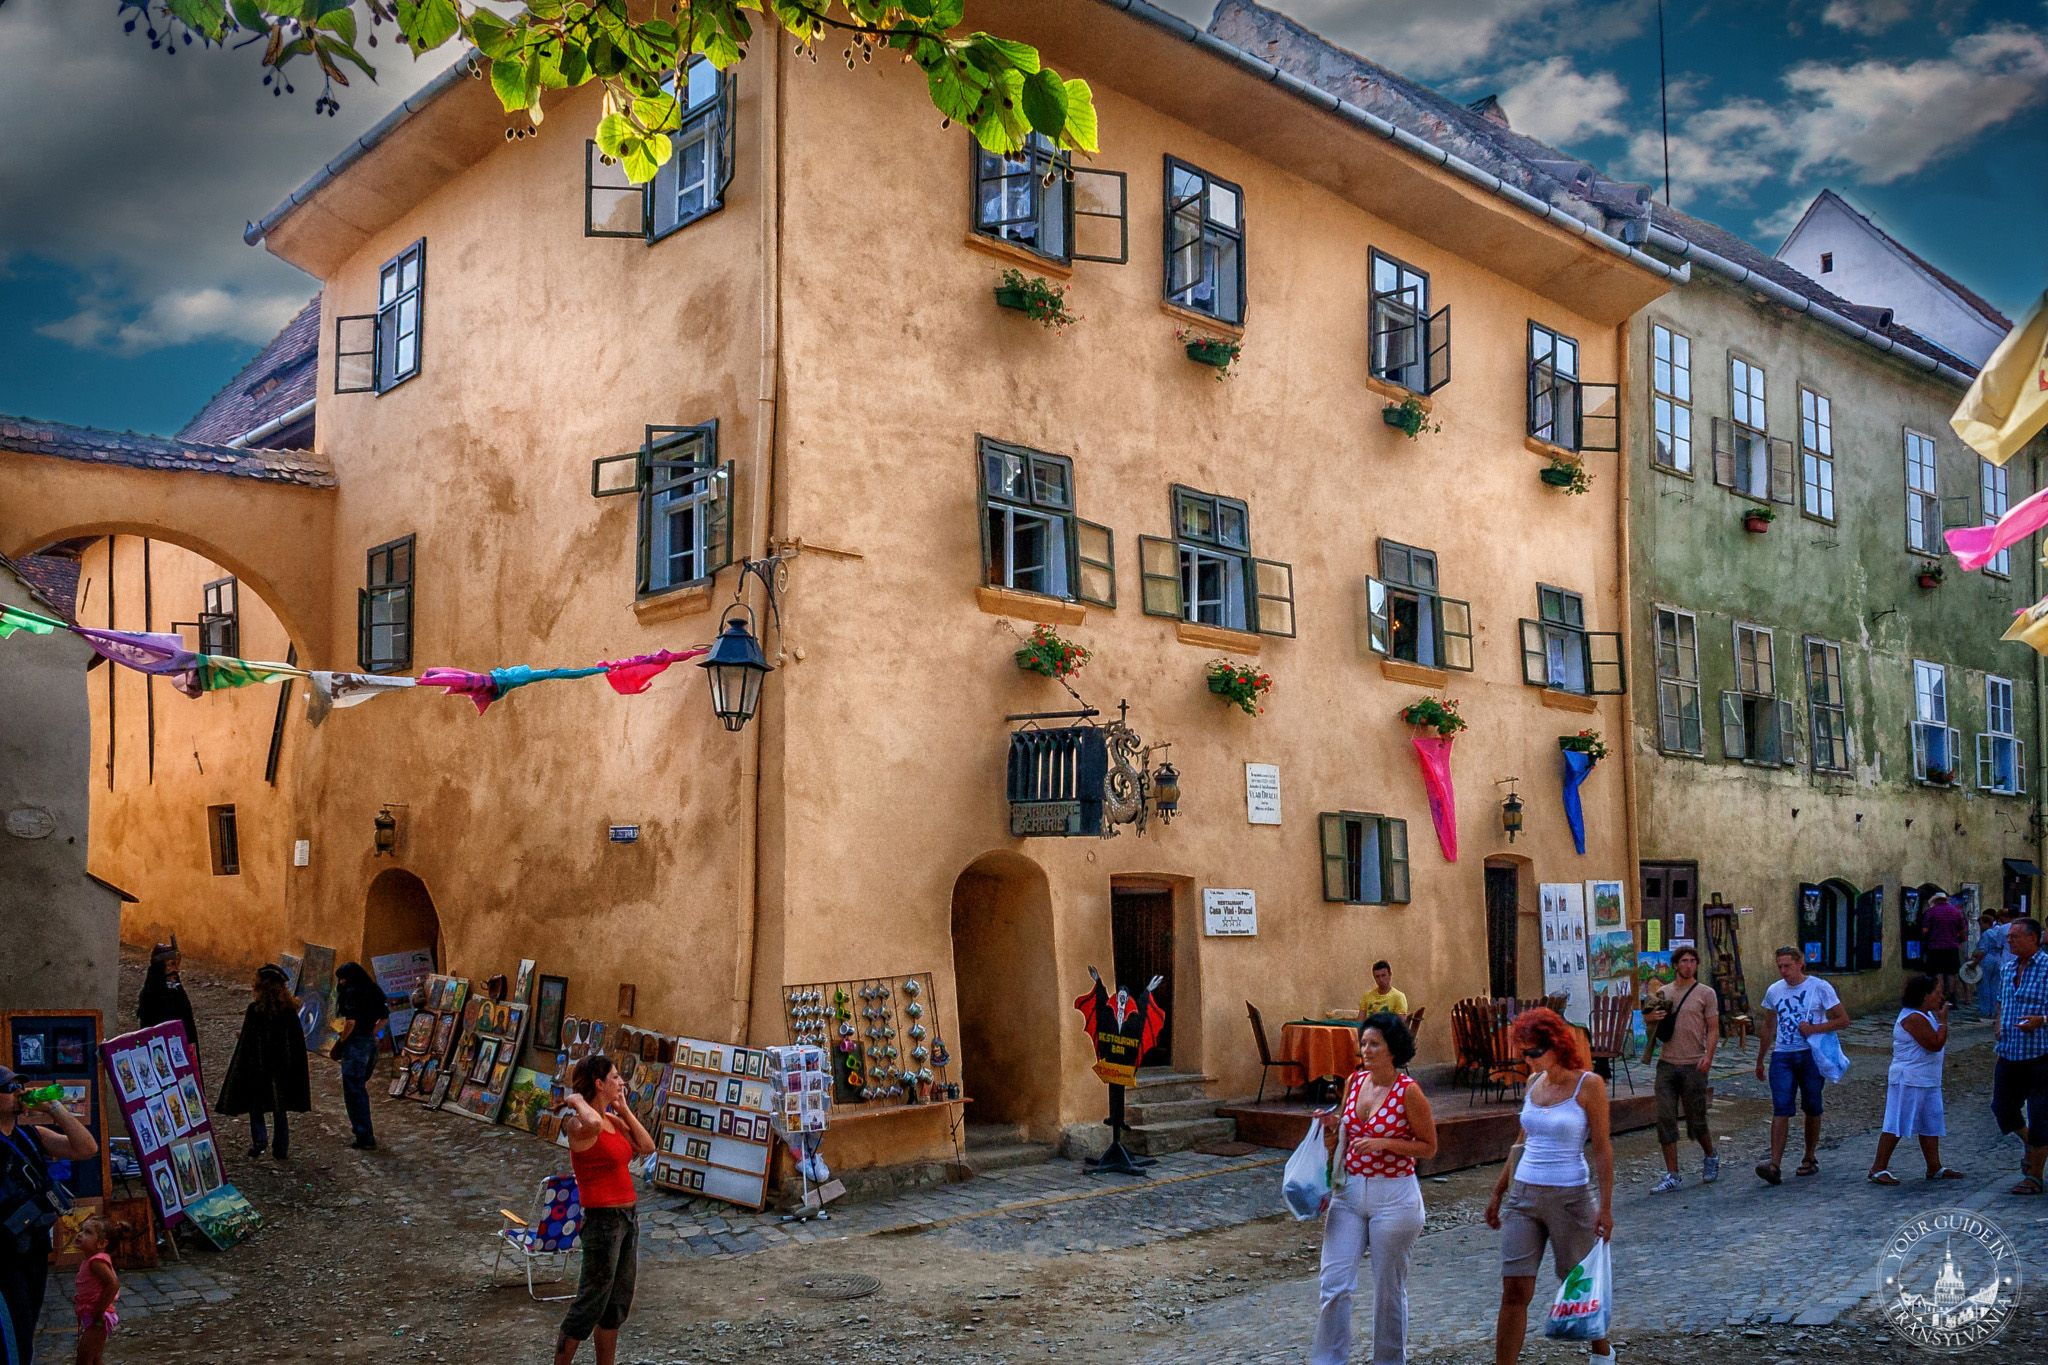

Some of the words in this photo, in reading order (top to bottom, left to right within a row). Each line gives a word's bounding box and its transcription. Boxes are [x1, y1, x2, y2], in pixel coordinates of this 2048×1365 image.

[1209, 906, 1222, 915] Casa
[1238, 906, 1253, 915] Dracul
[1098, 1031, 1140, 1048] RESTAURANT
[1111, 1044, 1125, 1055] BAR
